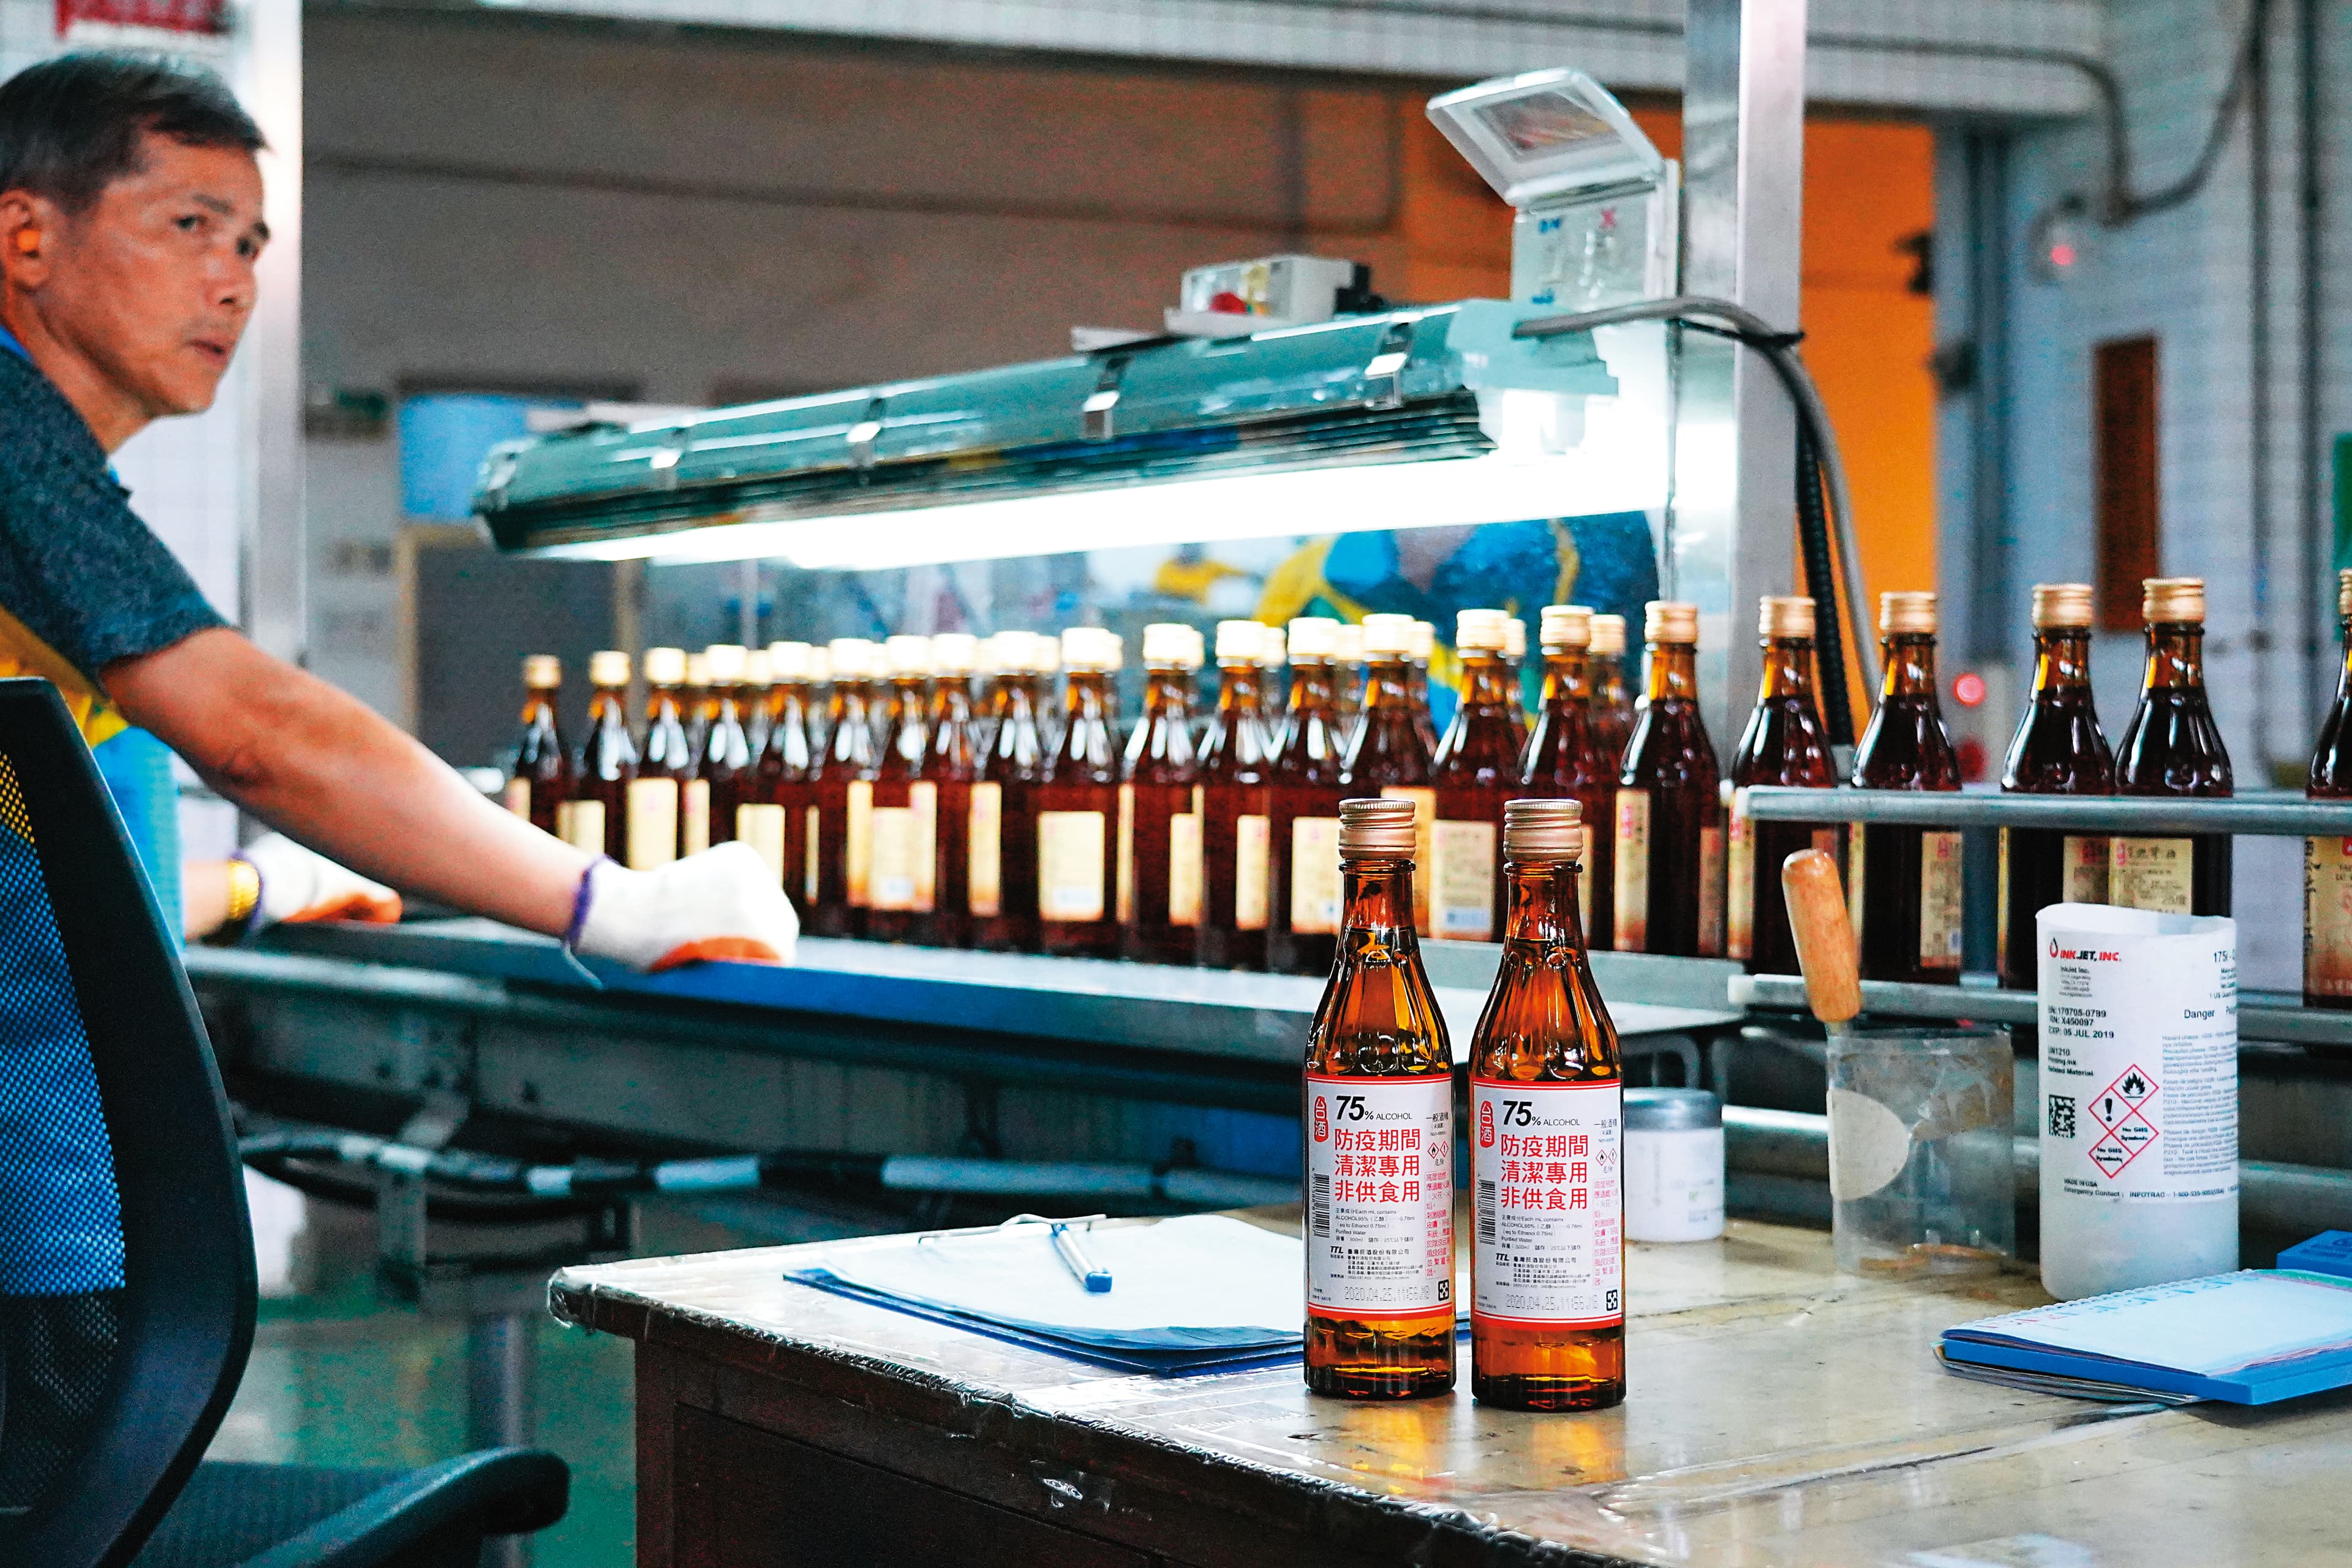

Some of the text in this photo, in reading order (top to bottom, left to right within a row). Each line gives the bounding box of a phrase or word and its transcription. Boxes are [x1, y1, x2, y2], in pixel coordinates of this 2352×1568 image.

[2098, 951, 2121, 961] INC.
[2062, 1017, 2094, 1026] X450097
[2184, 1009, 2215, 1020] Danger
[2074, 1029, 2089, 1038] JUL
[1335, 1129, 1420, 1151] 防疫期間
[1501, 1134, 1588, 1158] 防疫期間
[1335, 1154, 1419, 1177] 清潔專用
[1501, 1160, 1587, 1184] 清潔專用
[1335, 1180, 1419, 1203] 非供食用
[1501, 1186, 1587, 1210] 非供食用
